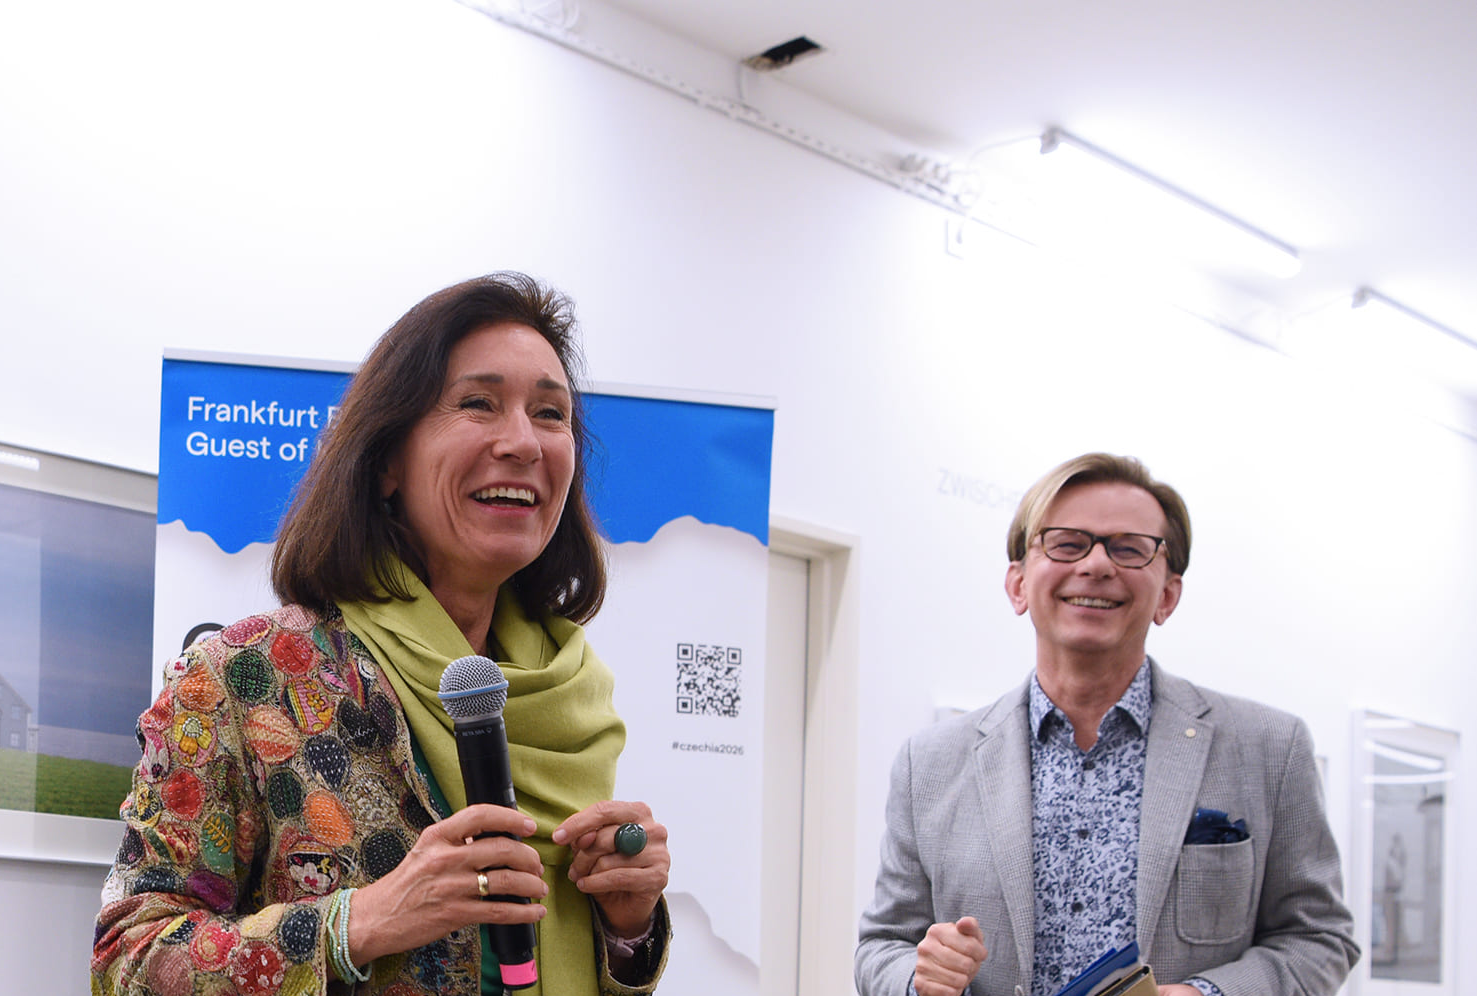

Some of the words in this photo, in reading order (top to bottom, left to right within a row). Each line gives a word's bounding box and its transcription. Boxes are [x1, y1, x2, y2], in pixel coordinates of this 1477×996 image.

[187, 396, 319, 429] Frankfurt
[186, 431, 271, 460] Guest
[278, 437, 309, 462] of
[671, 741, 745, 756] #czechia2026
